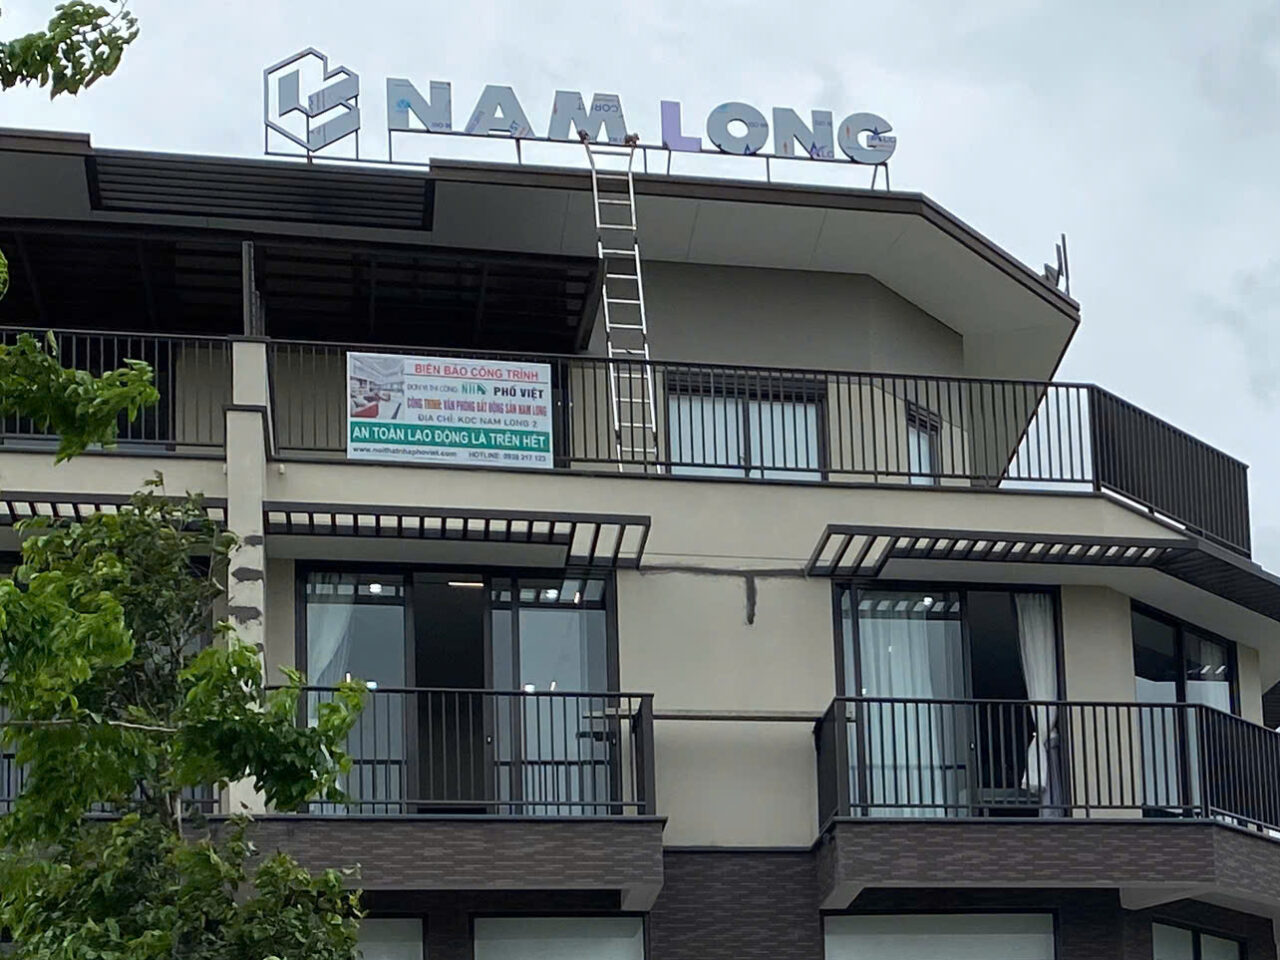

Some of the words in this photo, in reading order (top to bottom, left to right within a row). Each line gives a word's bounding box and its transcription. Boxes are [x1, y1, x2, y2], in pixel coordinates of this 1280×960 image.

[386, 77, 627, 145] NAM
[660, 99, 897, 164] LONG
[471, 366, 503, 379] CÔNG
[506, 368, 539, 381] TRÌNH
[520, 386, 544, 401] VIỆT
[458, 416, 477, 425] KDC
[480, 416, 501, 426] NAM
[504, 418, 529, 428] LONG
[532, 420, 537, 428] 2
[352, 426, 369, 439] AN
[372, 424, 405, 441] TOÀN
[408, 428, 432, 442] LAO
[434, 428, 469, 445] ĐỘNG
[472, 430, 487, 445] LÀ
[490, 432, 520, 447] TRÊN
[523, 433, 546, 448] HẾT
